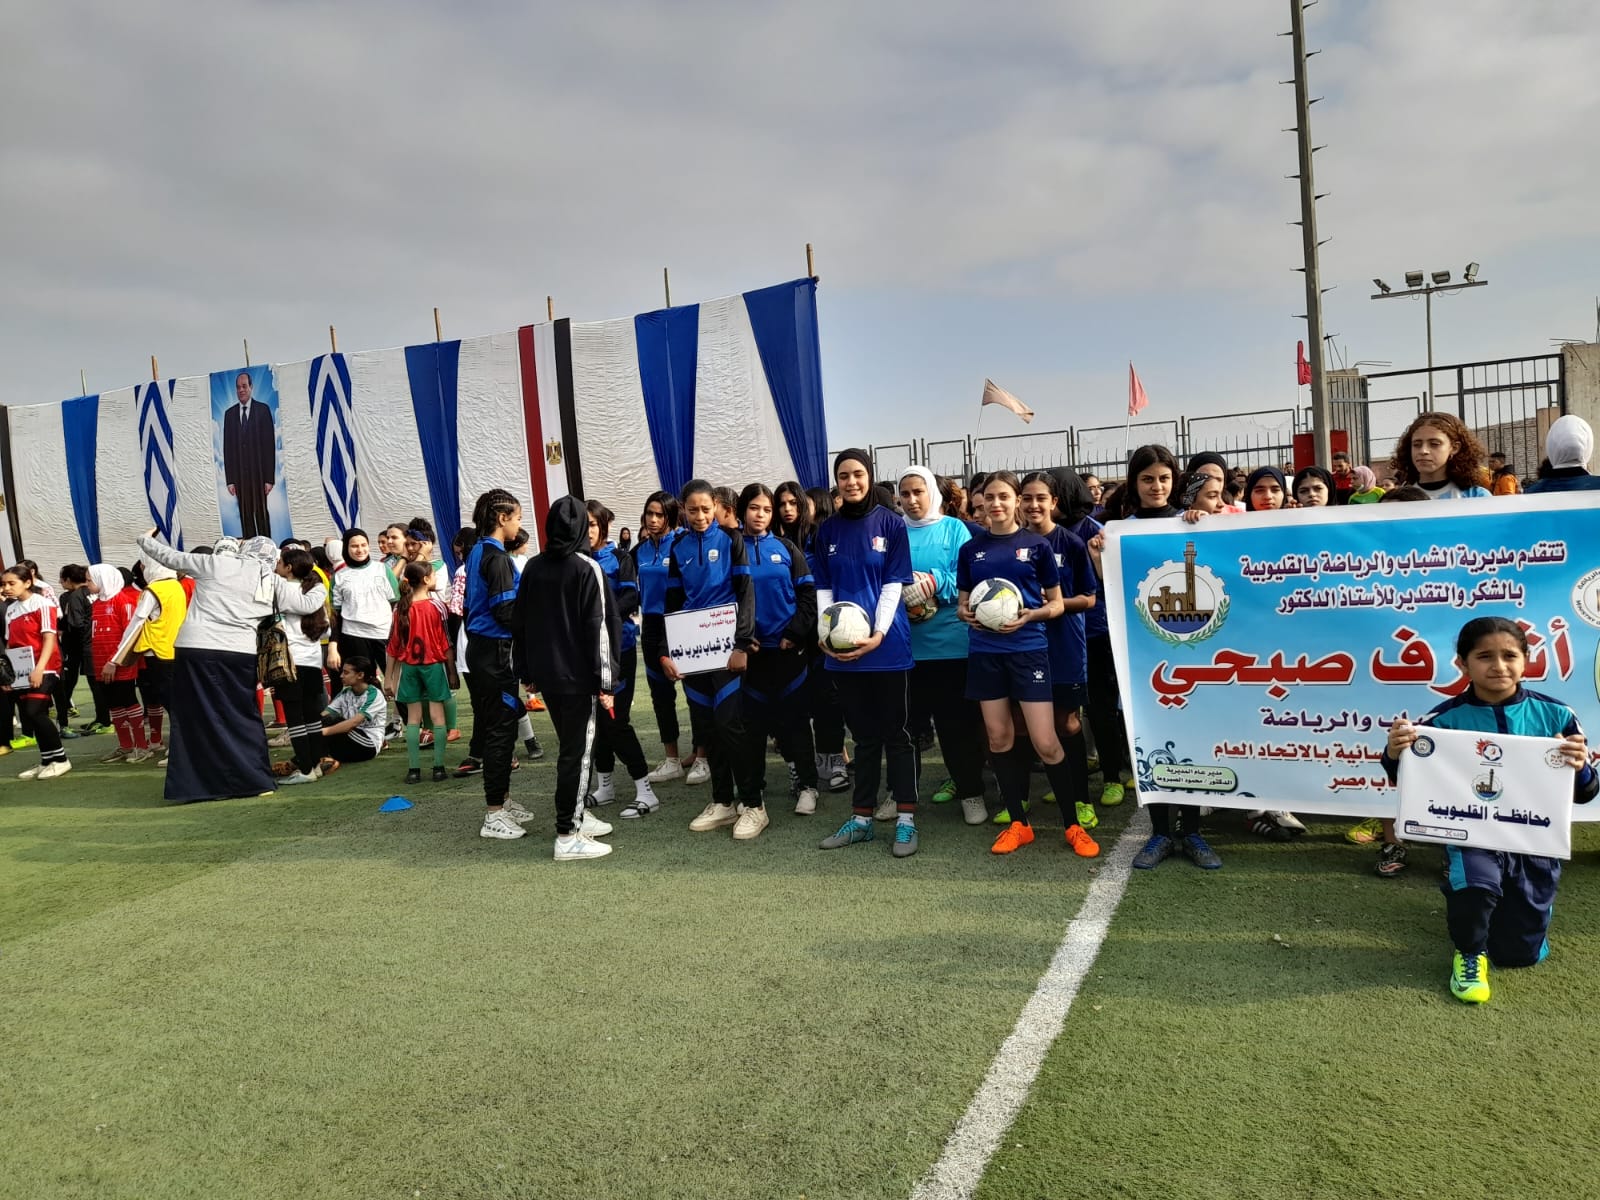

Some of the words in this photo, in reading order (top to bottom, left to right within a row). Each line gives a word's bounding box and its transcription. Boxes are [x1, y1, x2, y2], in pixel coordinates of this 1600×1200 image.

[1320, 551, 1394, 578] والرياضة
[1398, 546, 1455, 575] الشباب
[1457, 545, 1515, 573] مديرية
[1517, 542, 1565, 568] تتقدم
[1241, 555, 1319, 582] بالقليوبية
[1278, 588, 1336, 613] الدكتور
[1339, 583, 1395, 607] للأستاذ
[1394, 583, 1465, 611] والتقدير
[1467, 579, 1524, 607] بالشكر
[670, 643, 684, 661] نجم
[702, 636, 721, 656] شباب
[721, 636, 737, 654] ركز
[1151, 649, 1354, 708] صبحي
[1260, 708, 1372, 733] والرياضة
[1214, 741, 1253, 759] العام
[1257, 743, 1330, 765] بالاتحاد
[1328, 775, 1366, 791] مصر
[1427, 800, 1488, 822] القليوبية
[1492, 805, 1551, 828] محافظة
